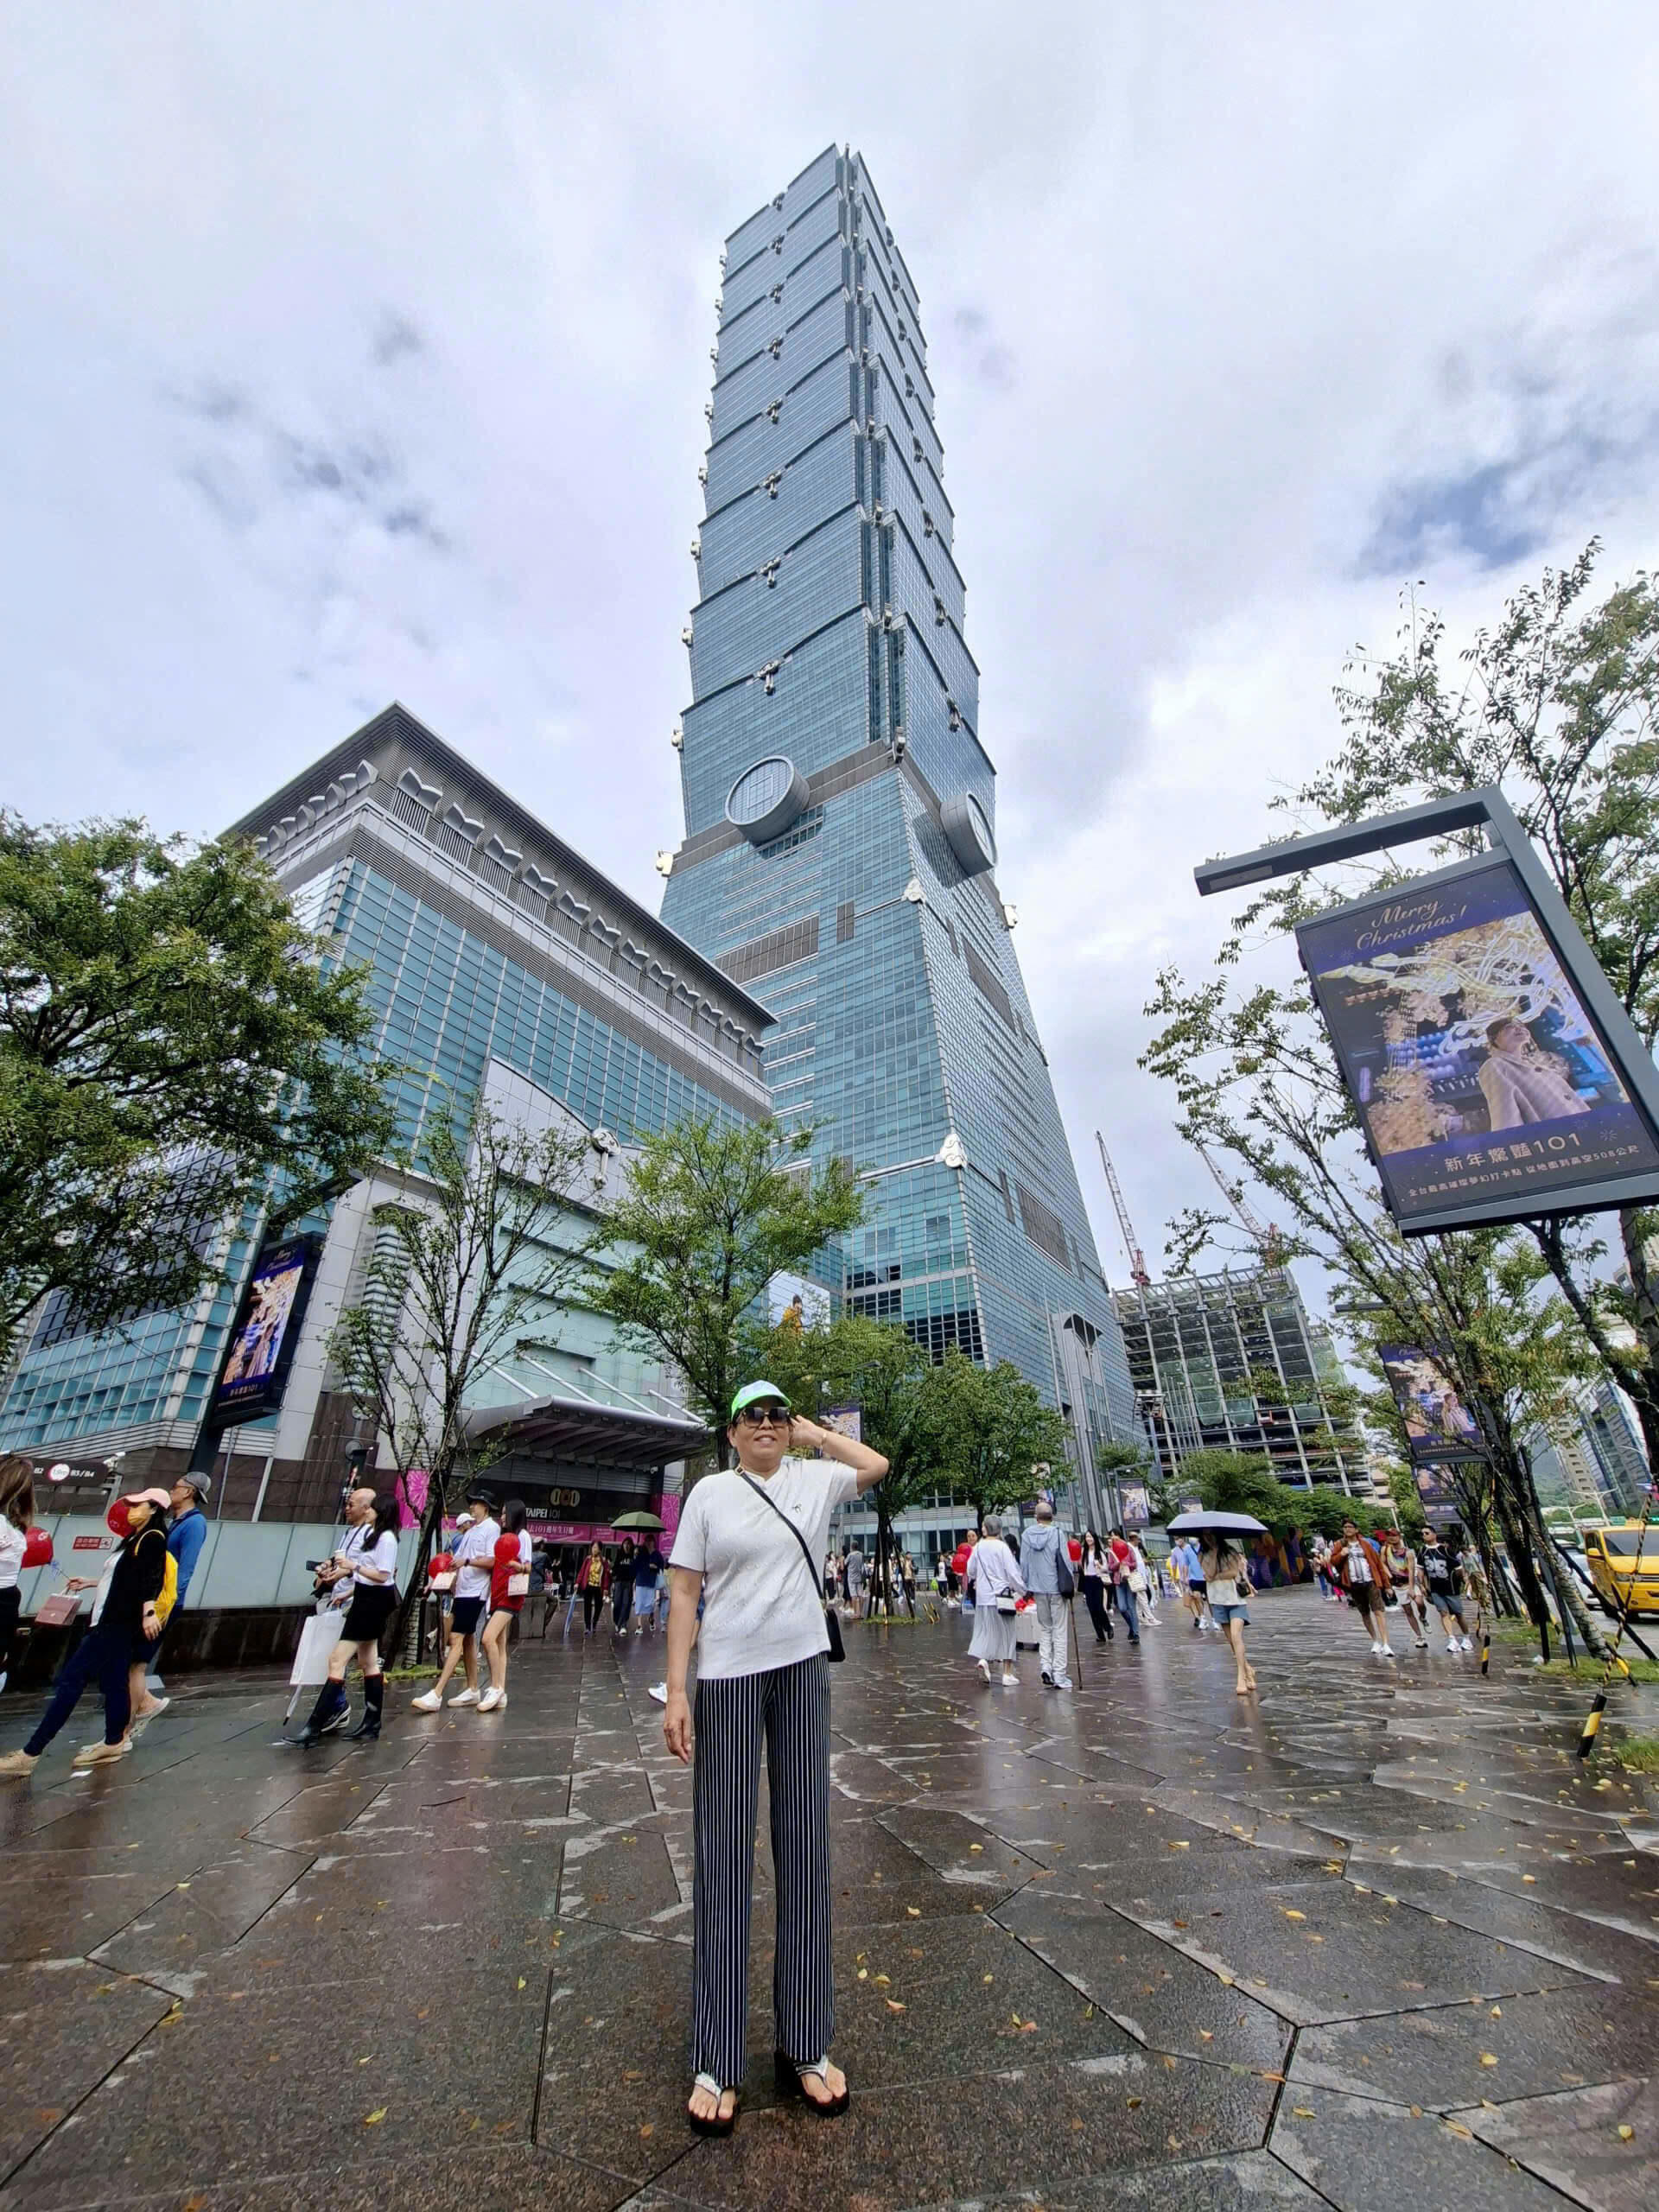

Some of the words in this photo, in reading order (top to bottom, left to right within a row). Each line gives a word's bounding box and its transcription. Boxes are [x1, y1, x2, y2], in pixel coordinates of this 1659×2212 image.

[1357, 905, 1467, 950] Christmas!
[1371, 900, 1443, 928] Merry
[525, 1507, 548, 1519] TAIPEI
